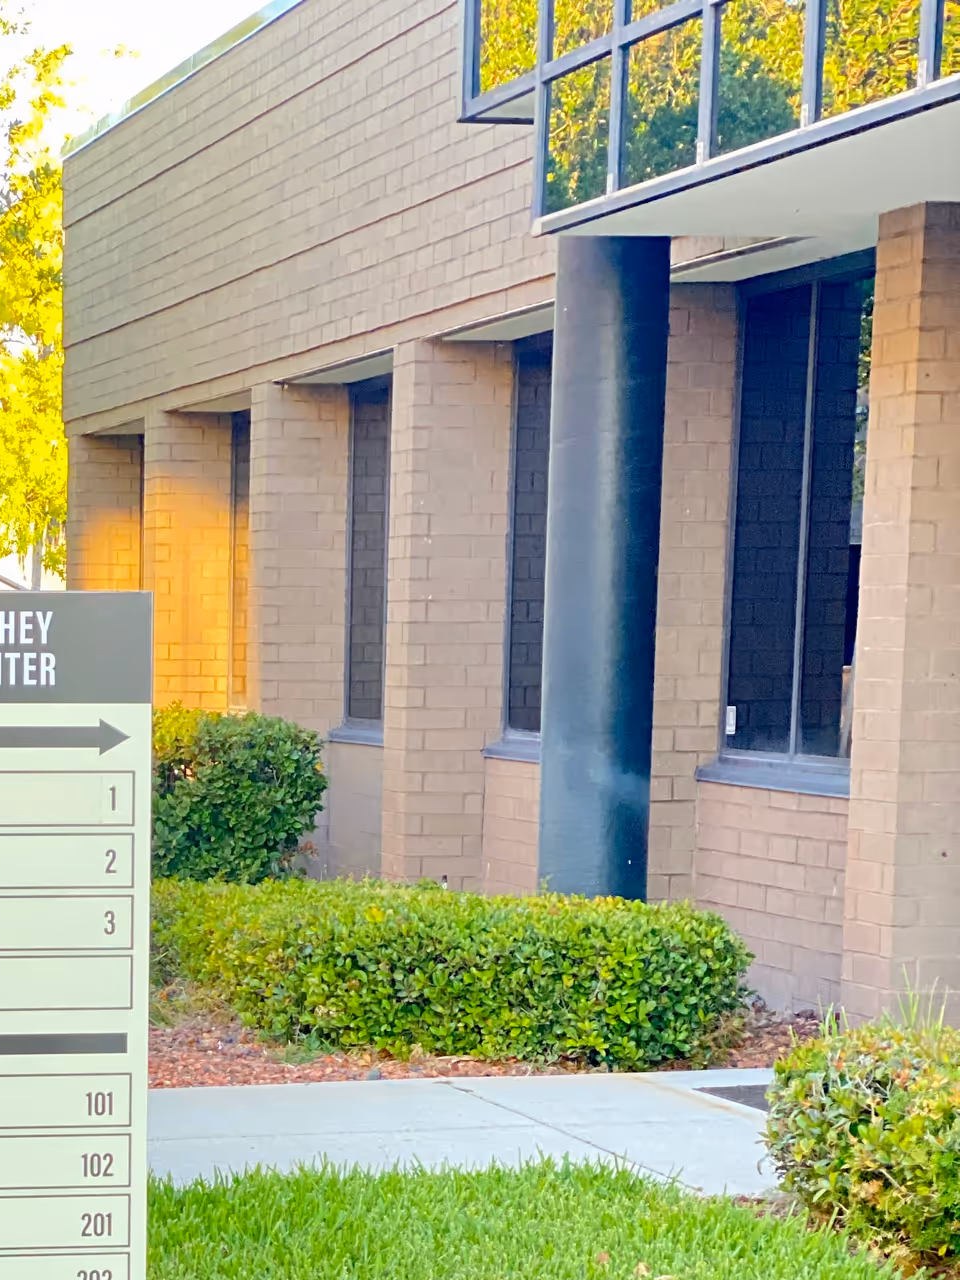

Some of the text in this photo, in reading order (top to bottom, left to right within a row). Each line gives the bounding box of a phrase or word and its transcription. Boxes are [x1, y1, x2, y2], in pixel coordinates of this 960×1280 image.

[108, 786, 117, 811] 1
[105, 849, 117, 874] 2
[103, 911, 116, 935] 3
[86, 1092, 113, 1115] 101
[81, 1153, 114, 1177] 102
[81, 1213, 112, 1236] 201
